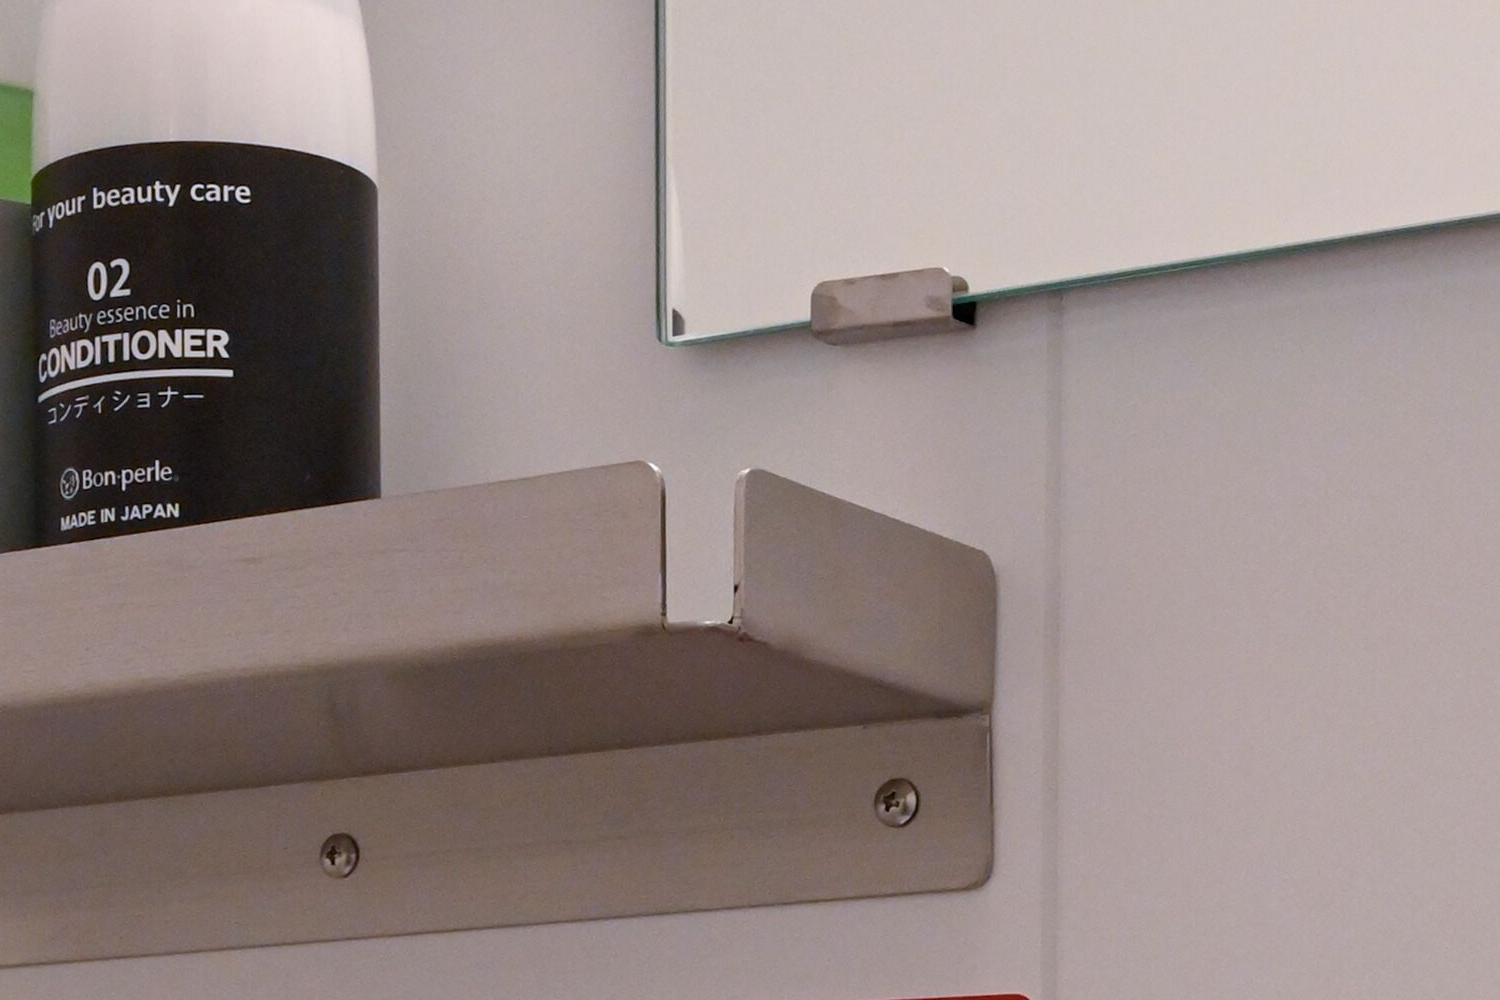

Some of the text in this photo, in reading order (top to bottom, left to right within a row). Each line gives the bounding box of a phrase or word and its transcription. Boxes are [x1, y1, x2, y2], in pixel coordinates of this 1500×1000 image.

[47, 195, 86, 229] your
[92, 180, 181, 209] beauty
[190, 183, 252, 204] care
[86, 257, 132, 301] 02
[49, 299, 195, 339] Beauty essence in
[38, 328, 230, 383] CONDITIONER
[47, 385, 205, 425] コンディショナー
[60, 503, 180, 532] MADE IN JAPAN
